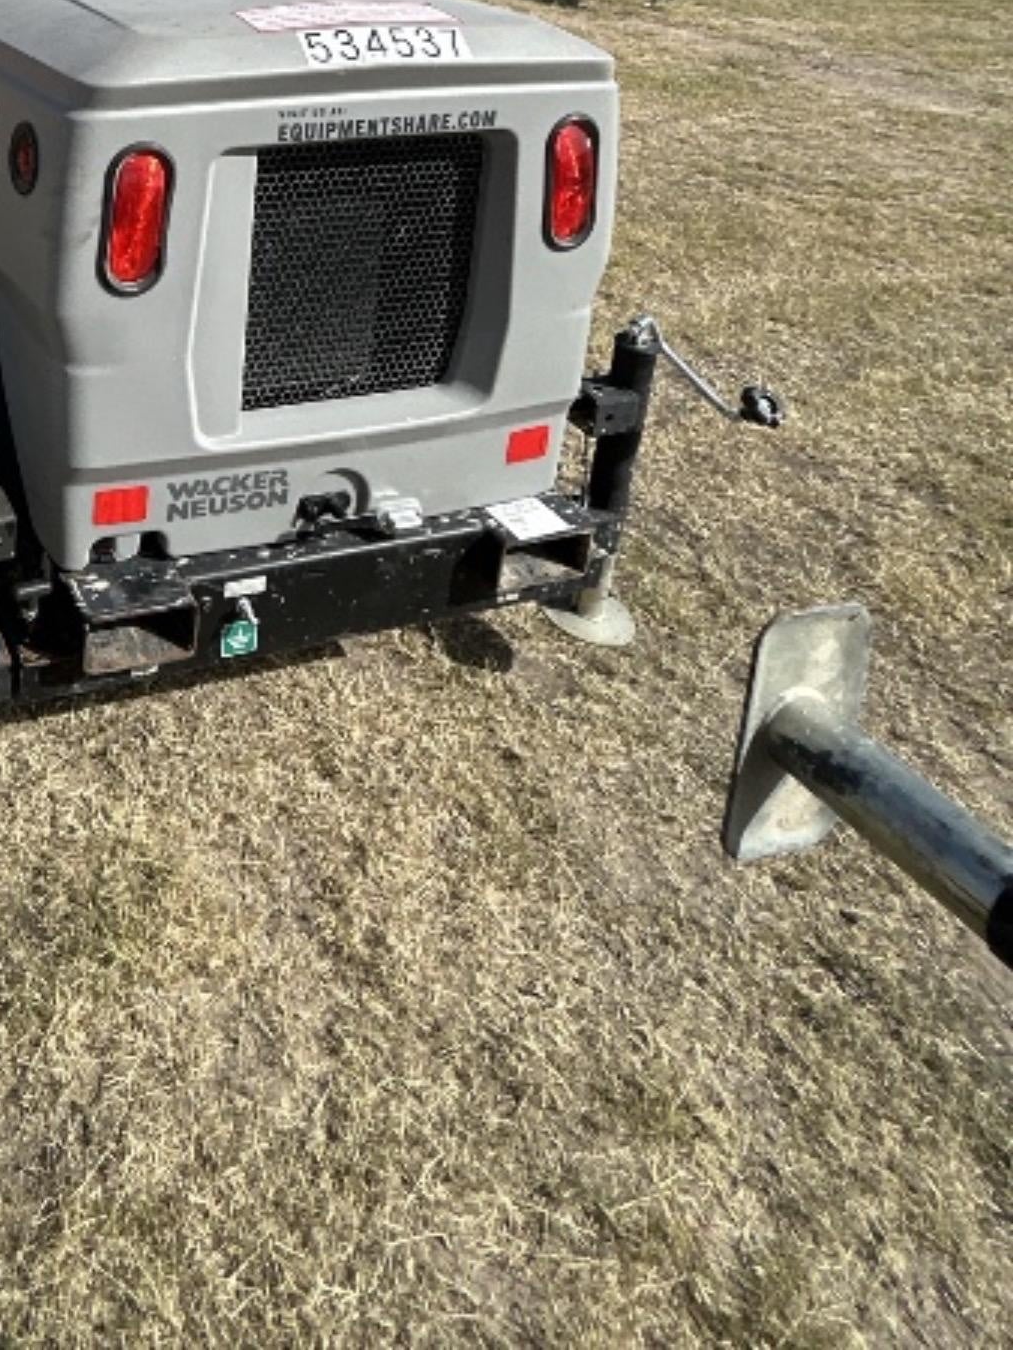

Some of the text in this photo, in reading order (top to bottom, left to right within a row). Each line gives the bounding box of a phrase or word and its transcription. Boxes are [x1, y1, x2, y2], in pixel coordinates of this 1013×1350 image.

[304, 26, 460, 64] 534537
[277, 109, 498, 142] EQUIPMENTSHARE.COM
[166, 467, 288, 501] WACKER
[166, 488, 288, 522] NEUSON
